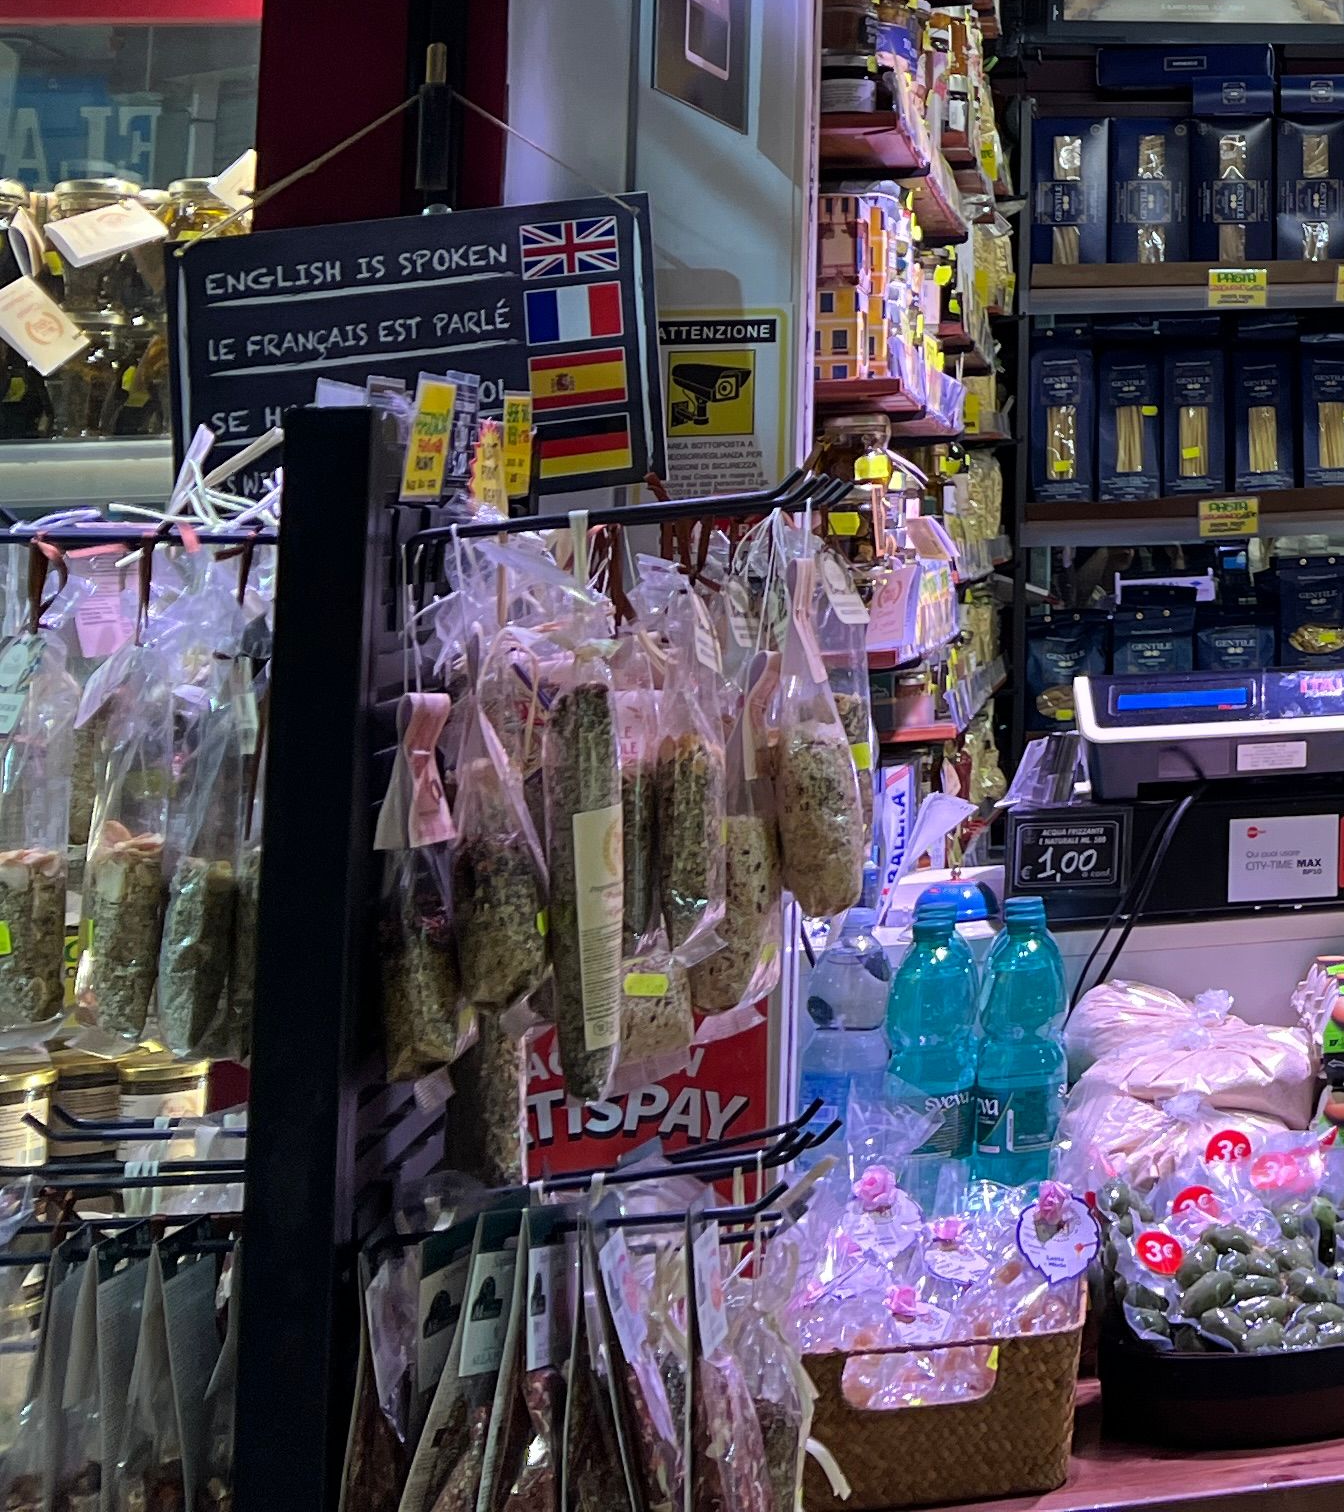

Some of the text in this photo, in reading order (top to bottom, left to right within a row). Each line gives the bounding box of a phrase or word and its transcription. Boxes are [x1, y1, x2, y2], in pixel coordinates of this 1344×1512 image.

[205, 243, 508, 296] ENGLISH IS SPOKEN
[1217, 272, 1257, 284] PASTA
[209, 298, 510, 361] LE FRANÇAIS EST PARLÉ
[659, 322, 772, 341] ATTENZIONE
[211, 410, 249, 436] SE
[1209, 501, 1248, 513] PASTA
[1038, 848, 1098, 882] 1,00
[1246, 858, 1322, 872] CITY-TIME MAX
[526, 1085, 749, 1143] TISPAY
[1145, 1237, 1175, 1262] 3€
